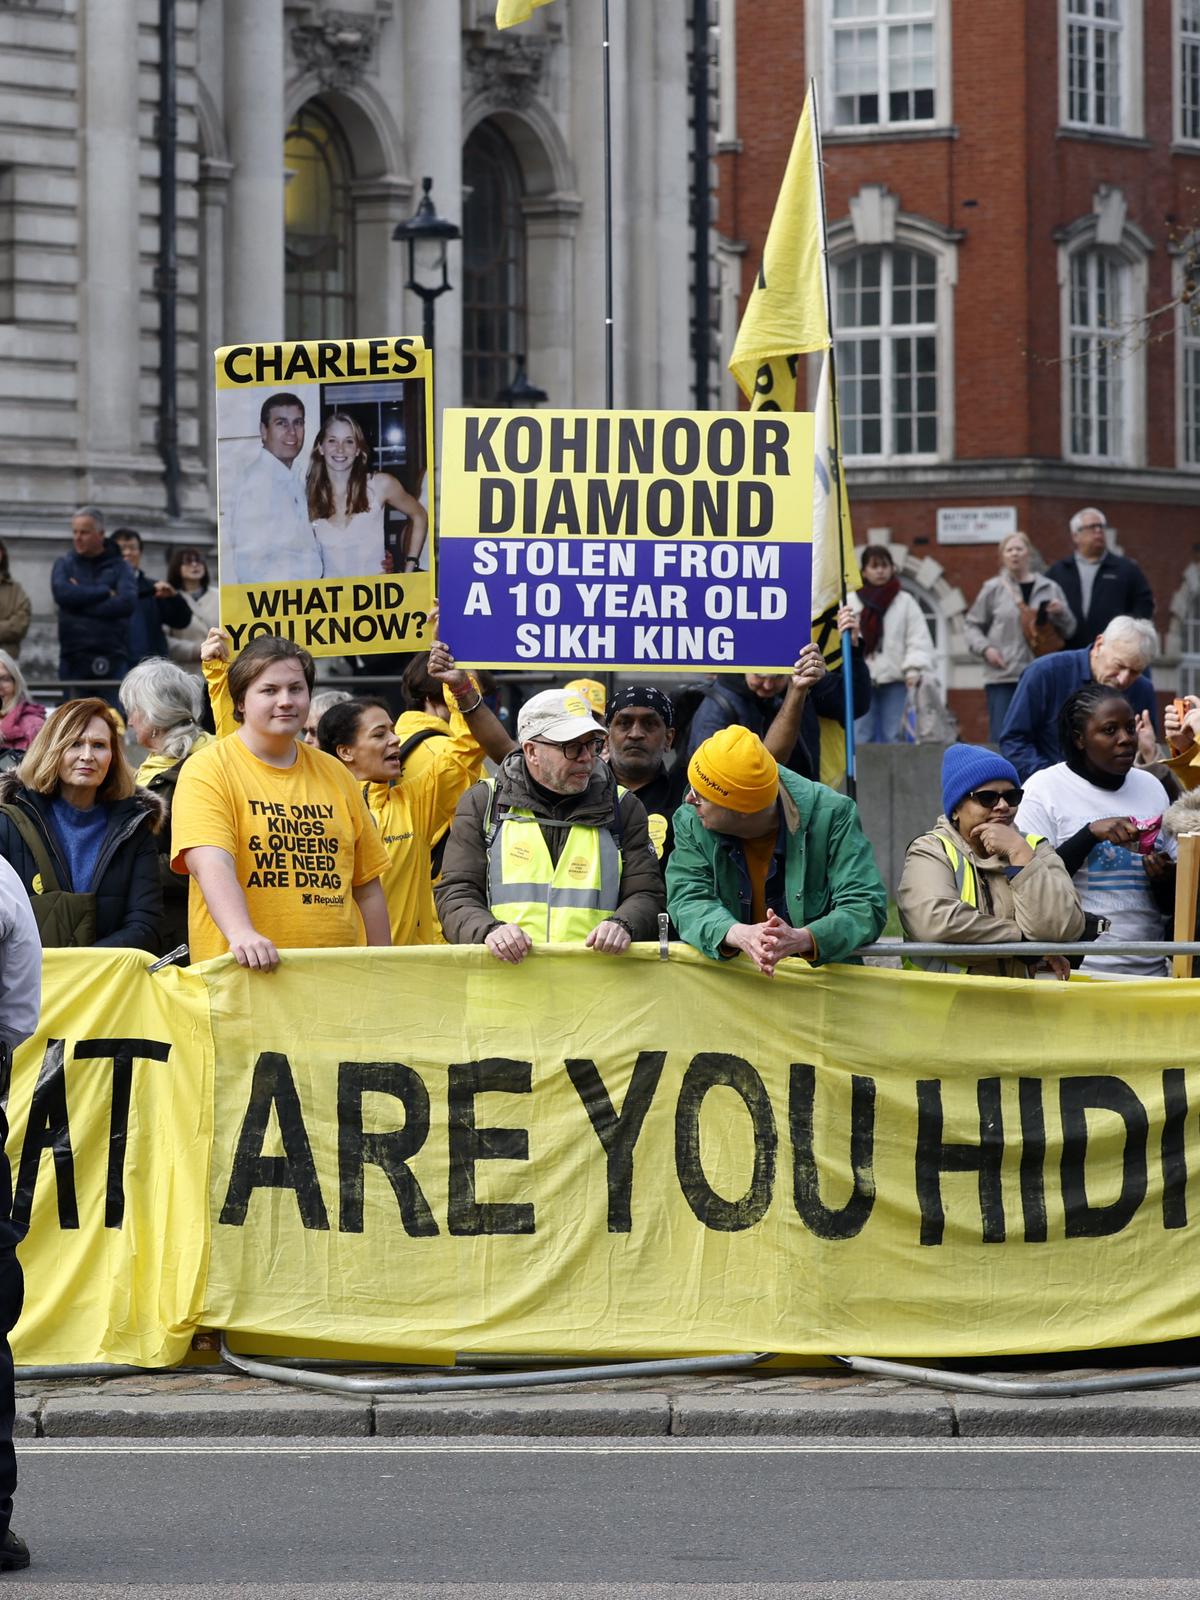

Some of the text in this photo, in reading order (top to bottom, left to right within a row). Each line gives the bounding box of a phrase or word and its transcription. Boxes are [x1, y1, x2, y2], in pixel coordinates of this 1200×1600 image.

[223, 338, 418, 384] CHARLES
[463, 416, 791, 476] KOHINOOR
[478, 477, 774, 537] DIAMOND
[473, 541, 780, 579] STOLEN FROM
[247, 582, 405, 618] WHAT DID
[463, 582, 788, 620] A 10 YEAR OLD
[305, 611, 428, 646] KNOW?
[515, 624, 735, 660] SIKH KING
[248, 800, 334, 820] THE ONLY
[267, 817, 325, 837] KINGS
[248, 834, 339, 854] & QUEENS
[254, 853, 336, 871] WE NEED
[246, 871, 342, 889] ARE DRAG
[219, 1051, 536, 1237] ARE
[564, 1050, 876, 1241] YOU
[916, 1068, 1200, 1246] HIDI
